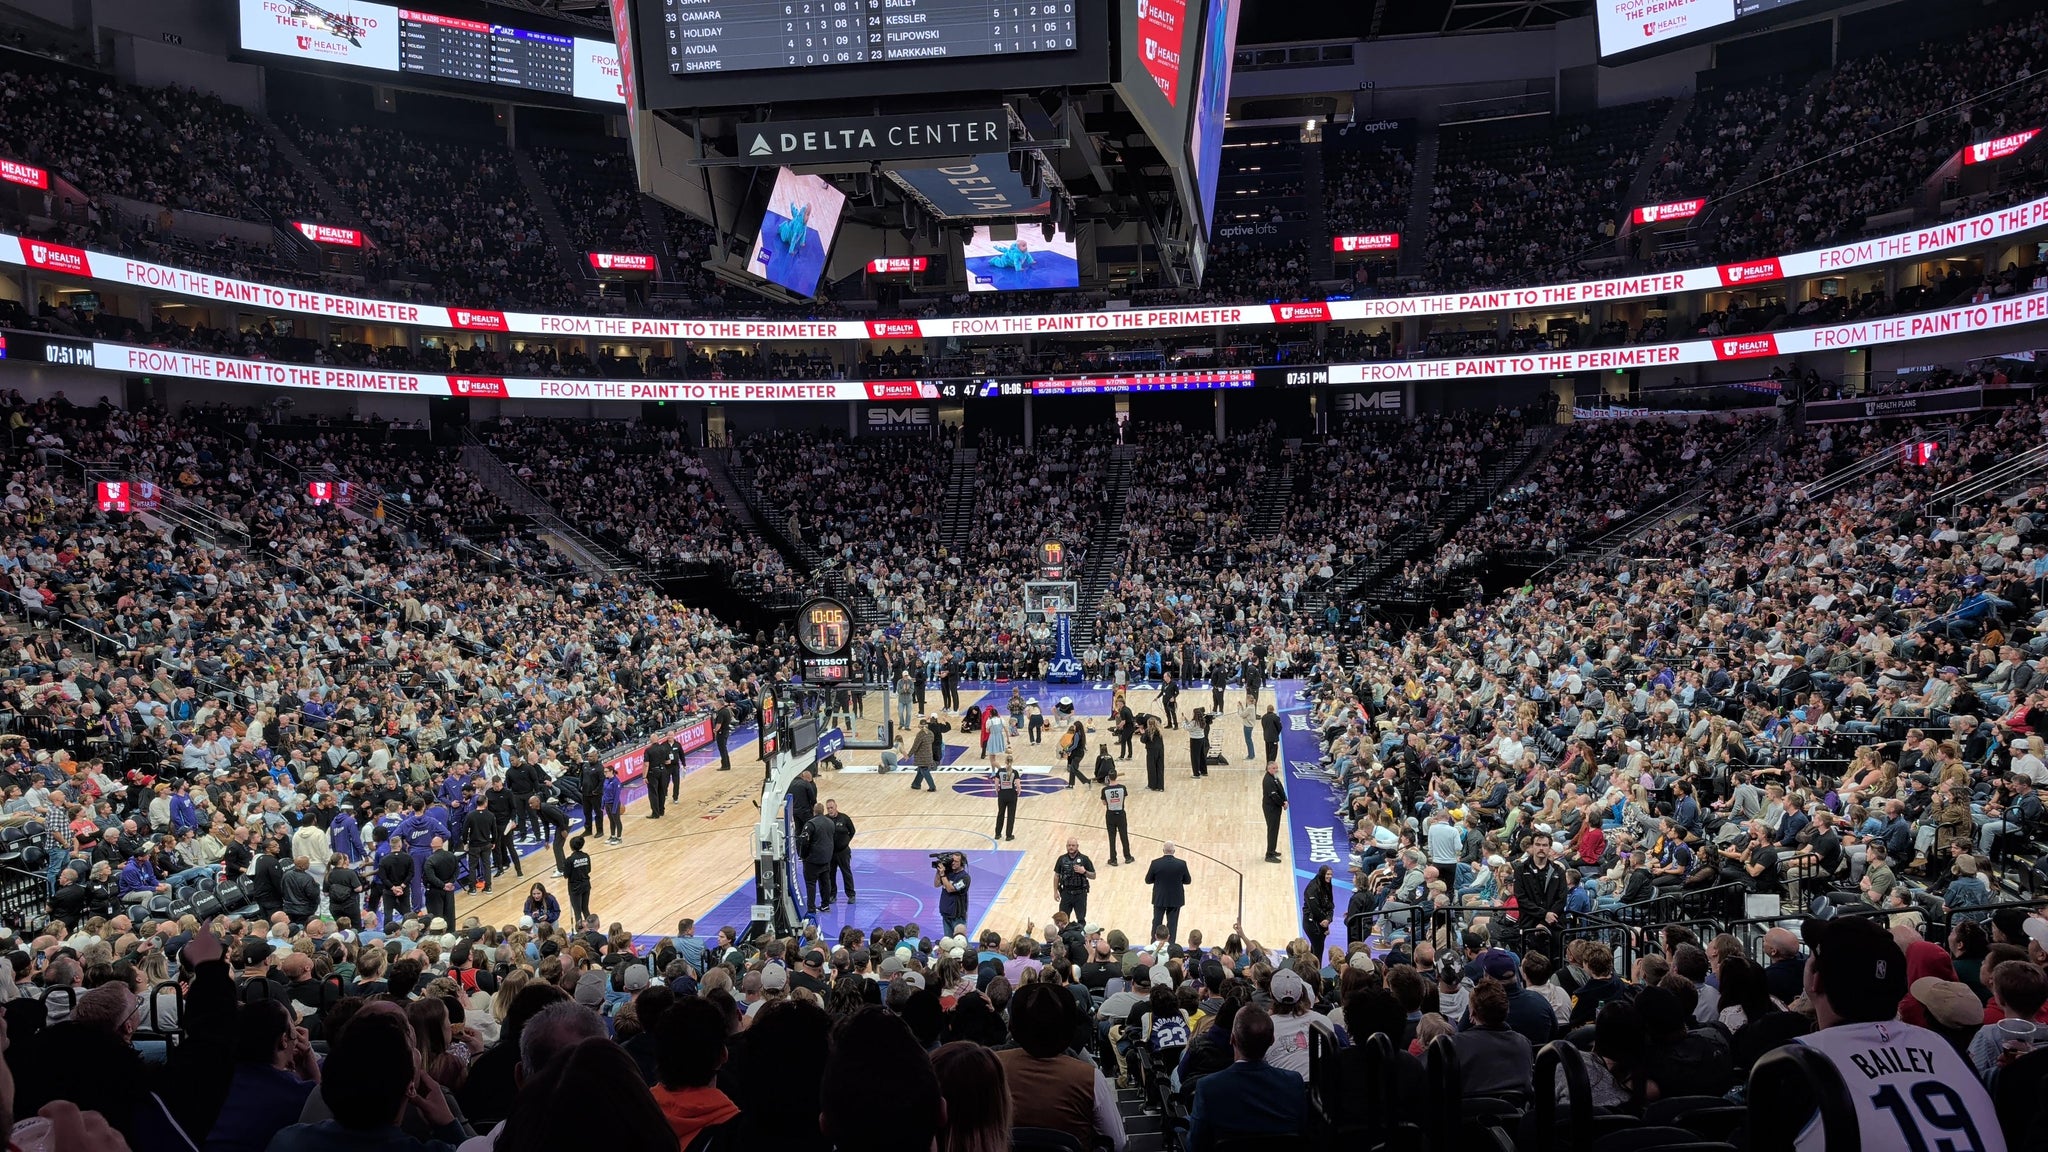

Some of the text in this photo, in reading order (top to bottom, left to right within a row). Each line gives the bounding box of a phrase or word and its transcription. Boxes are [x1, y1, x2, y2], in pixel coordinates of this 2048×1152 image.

[276, 15, 298, 26] THE
[666, 3, 846, 22] 33 CAMARA 6 08
[869, 6, 1056, 25] 24 KESSLER 5 08
[1149, 6, 1174, 25] HEALTH
[1626, 11, 1644, 21] THE
[363, 18, 378, 28] TO
[670, 19, 847, 38] 5 HOLIDAY 2 08
[1658, 16, 1687, 29] HEALTH
[870, 23, 1056, 42] 22 FILIPOWSKI 2 05
[314, 40, 348, 51] HEALTH
[672, 36, 848, 55] 8 AVDIJA 4 09
[871, 40, 1055, 59] 23 MARKKANEN 11 10
[672, 53, 849, 72] 17 SHARPE 2 06
[601, 66, 619, 76] THE
[1365, 120, 1398, 133] aptive
[780, 122, 998, 152] DELTA CENTER
[1992, 132, 2032, 152] HEALTH
[1, 160, 39, 180] HEALTH
[937, 164, 1012, 209] DELTA
[1660, 202, 1696, 216] HEALTH
[318, 226, 354, 239] HEALTH
[1220, 222, 1277, 238] aptive lofts
[1820, 245, 1872, 267] FROM
[1879, 236, 1910, 256] THE
[1918, 224, 1967, 250] PAINT
[1971, 218, 1994, 237] TO
[1999, 208, 2028, 231] THE
[1359, 235, 1391, 246] HEALTH
[48, 251, 80, 266] HEALTH
[613, 256, 646, 265] HEALTH
[1744, 264, 1774, 276] HEALTH
[127, 262, 418, 320] FROM THE PAINT TO THE PERIMETER
[1366, 275, 1684, 314] FROM THE PAINT TO THE PERIMETER
[471, 314, 499, 323] HEALTH
[953, 309, 1241, 333] FROM THE PAINT TO THE PERIMETER
[1294, 308, 1322, 318] HEALTH
[541, 318, 837, 336] FROM THE PAINT TO THE PERIMETER
[886, 324, 914, 332] HEALTH
[1814, 324, 1867, 346] FROM
[1873, 320, 1904, 338] THE
[1912, 312, 1961, 335] PAINT
[1965, 308, 1988, 327] TO
[1993, 302, 2022, 323] THE
[1739, 340, 1768, 352] HEALTH
[46, 344, 92, 366] 07:51 PM
[1362, 347, 1679, 379] FROM THE PAINT TO THE PERIMETER
[129, 350, 418, 391] FROM THE PAINT TO THE PERIMETER
[1287, 372, 1327, 385] 07:51 PM
[471, 382, 499, 390] HEALTH
[541, 383, 836, 398] FROM THE PAINT TO THE PERIMETER
[943, 386, 956, 396] 43
[964, 385, 976, 396] 47
[1001, 383, 1021, 394] 10:06
[1335, 391, 1400, 410] SME
[1876, 400, 1916, 409] HEALTH PLANS
[868, 408, 930, 424] SME
[1047, 550, 1060, 562] 17
[811, 609, 842, 624] 10:06
[820, 624, 841, 647] 17
[816, 658, 848, 666] TISSOT
[1110, 790, 1119, 799] 35
[1305, 826, 1340, 863] SEATGEEK
[1158, 1027, 1187, 1048] 23
[1850, 1046, 1935, 1079] BAILEY
[1869, 1080, 1984, 1152] 19
